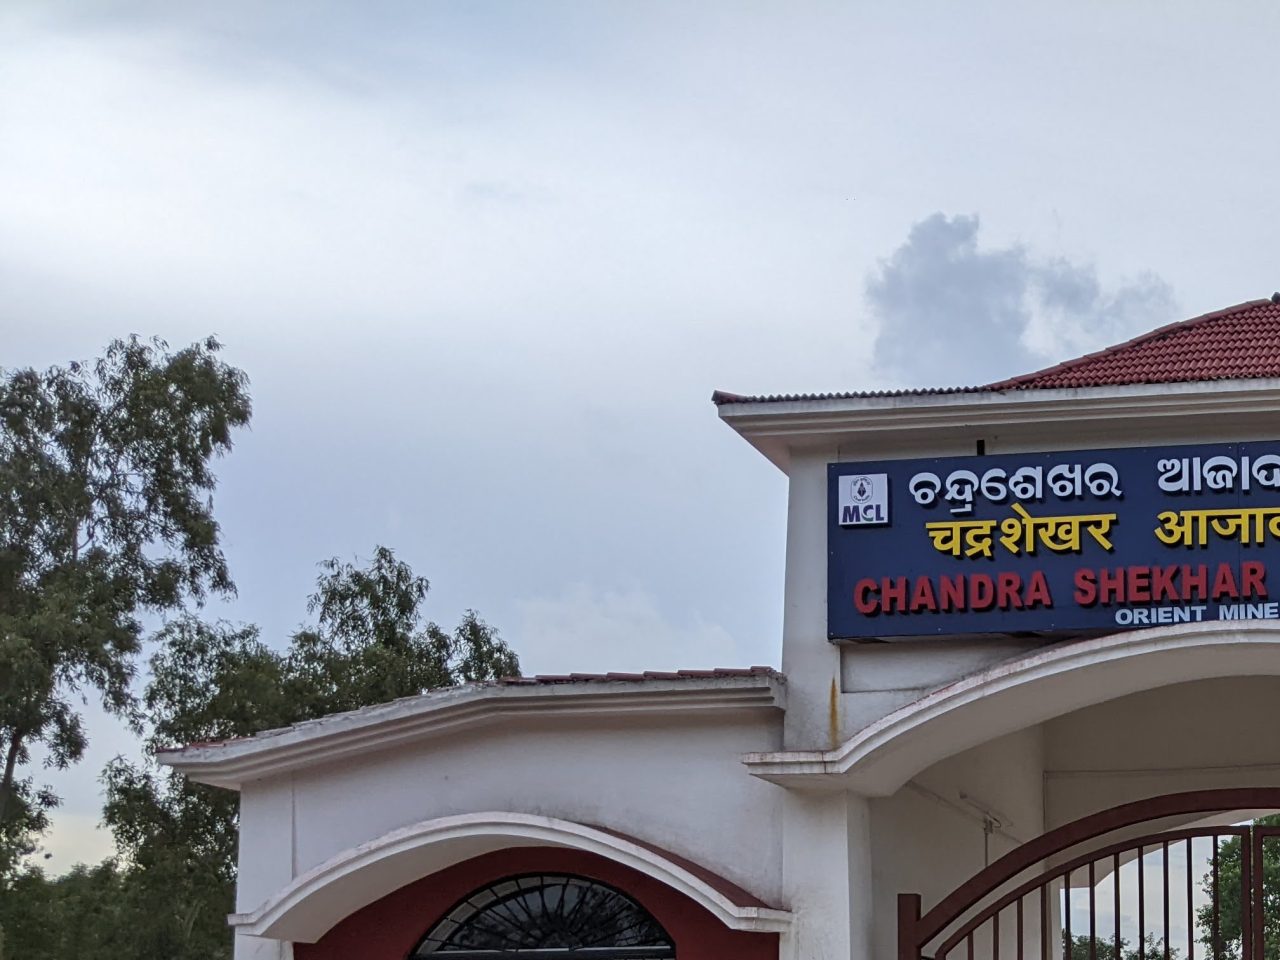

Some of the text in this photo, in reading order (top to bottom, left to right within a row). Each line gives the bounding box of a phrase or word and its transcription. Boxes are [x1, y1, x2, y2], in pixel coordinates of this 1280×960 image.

[908, 463, 1122, 513] ଚନ୍ଦ୍ରଶେଖର
[842, 504, 884, 523] MCL
[854, 571, 1051, 614] CHANDRA
[1074, 562, 1266, 604] SHEKHAR
[1115, 605, 1207, 625] ORIENT
[1218, 602, 1279, 620] MINE
